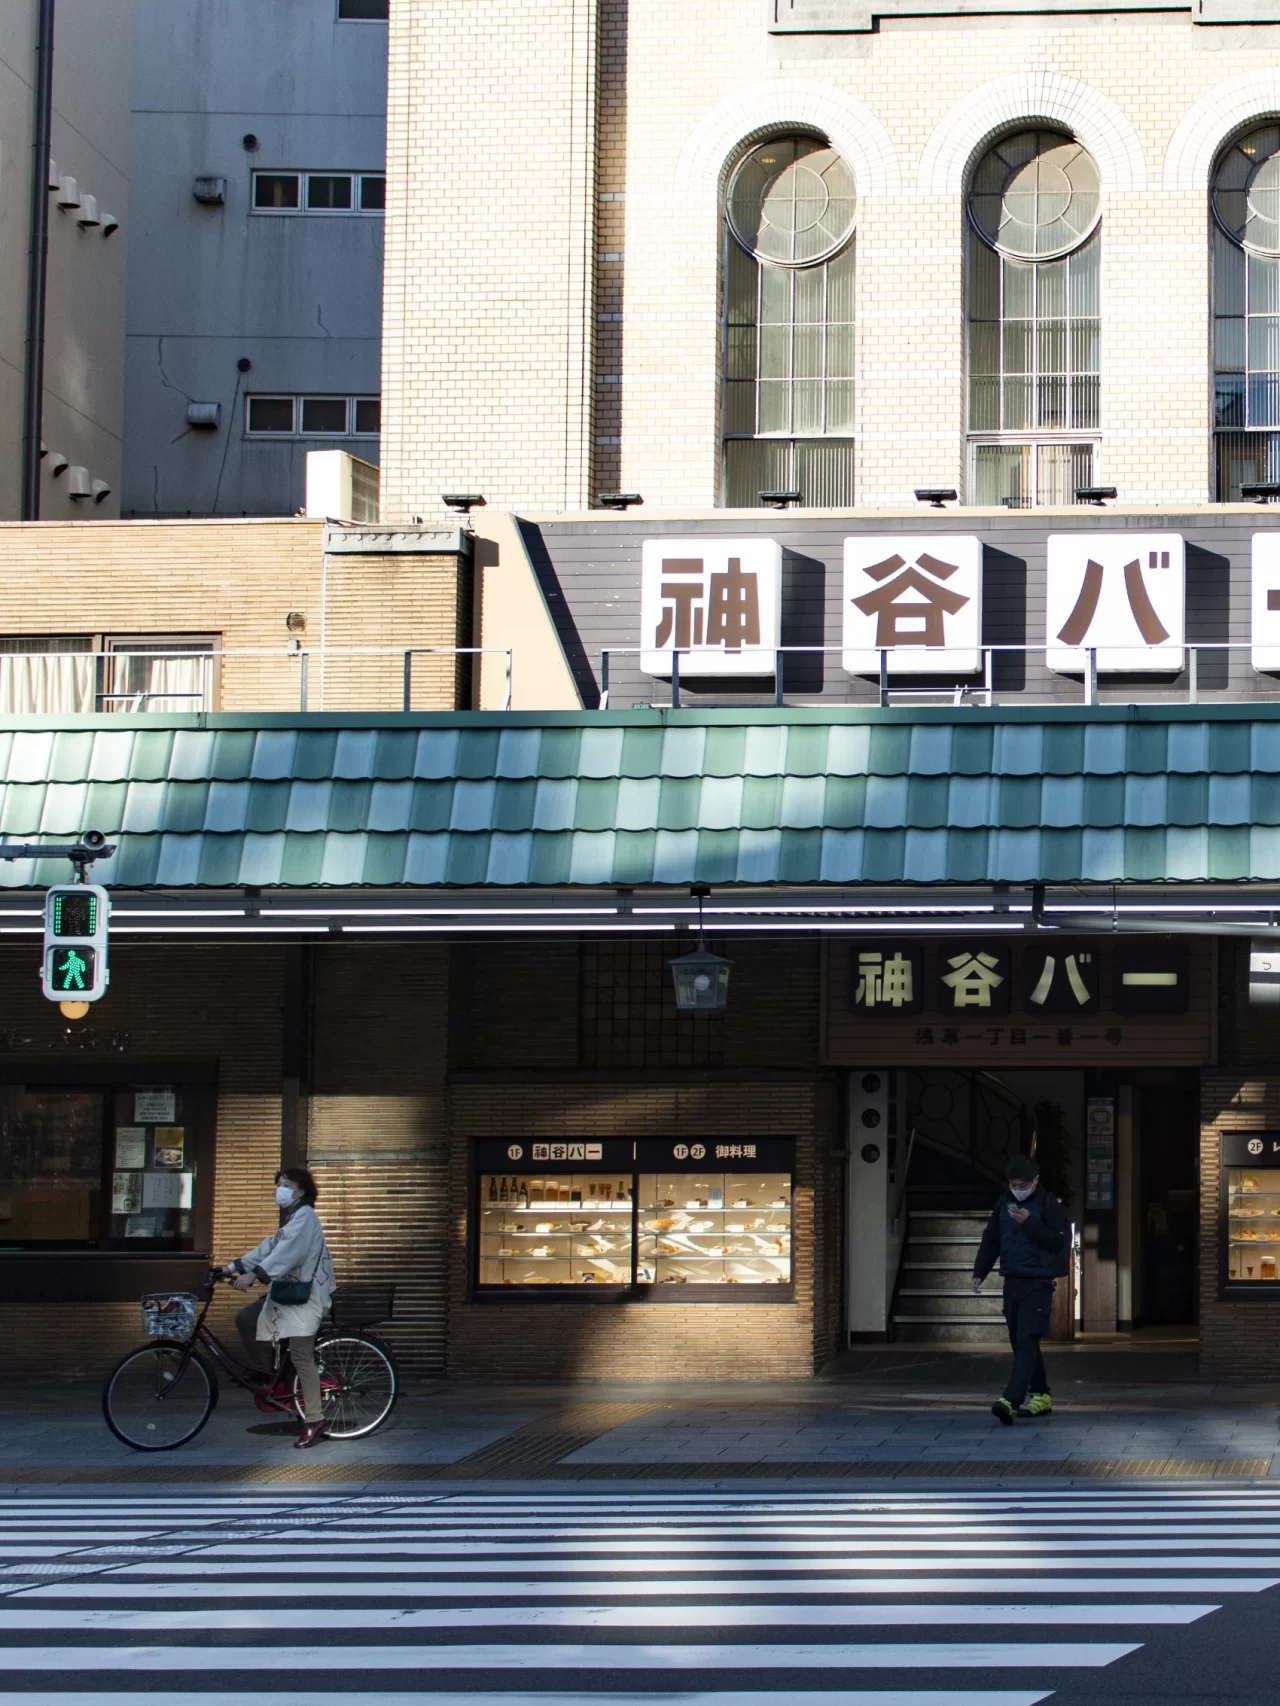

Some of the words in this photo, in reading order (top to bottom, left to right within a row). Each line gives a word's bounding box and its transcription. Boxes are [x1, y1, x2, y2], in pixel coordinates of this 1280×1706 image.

[855, 951, 1178, 1008] 神谷バー
[915, 1026, 1125, 1047] 浅草一丁目一番一号
[508, 1145, 523, 1159] 1F
[532, 1144, 603, 1160] 神谷バー
[674, 1145, 689, 1159] 1F
[690, 1144, 706, 1159] 2F
[715, 1144, 757, 1159] 御料理
[1249, 1139, 1263, 1154] 2F
